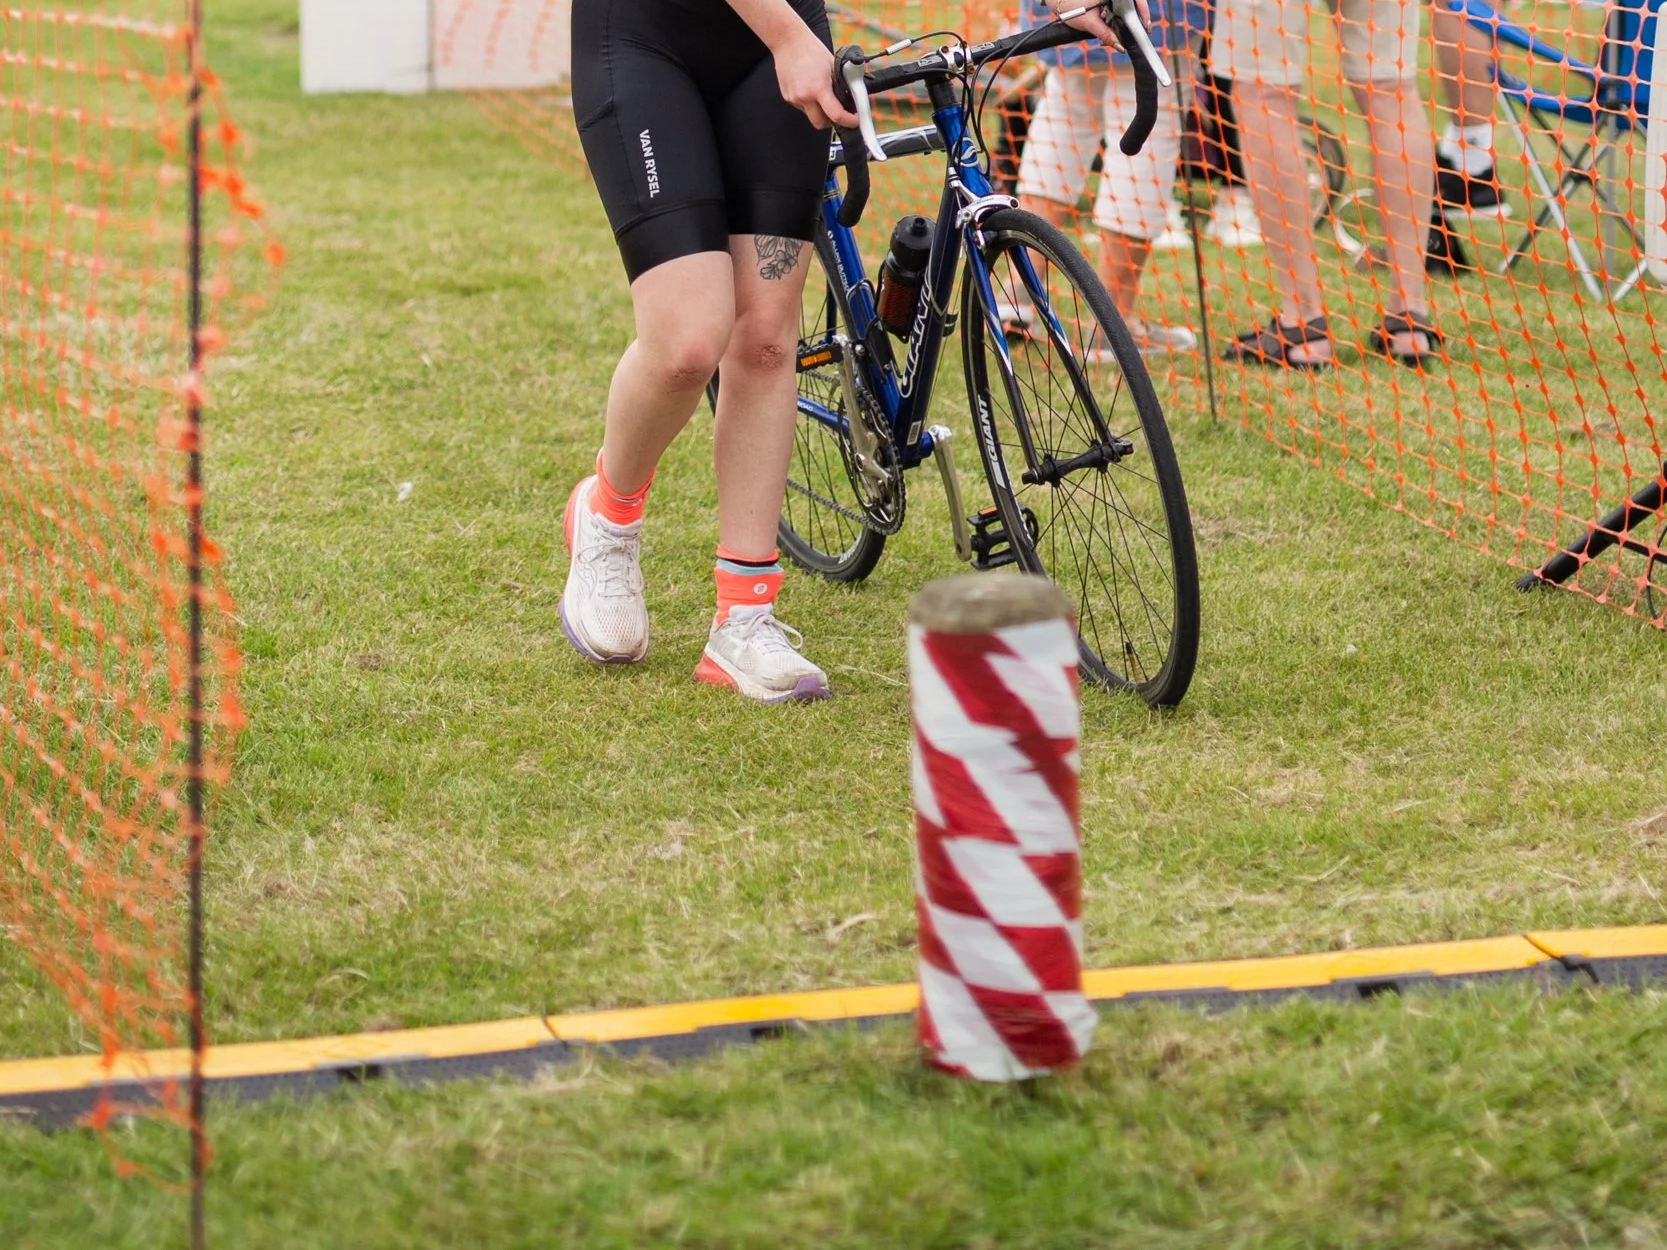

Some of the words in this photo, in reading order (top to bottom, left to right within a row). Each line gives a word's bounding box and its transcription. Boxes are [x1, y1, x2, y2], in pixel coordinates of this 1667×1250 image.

[639, 129, 654, 158] VAN
[645, 159, 660, 198] RYSEL
[977, 394, 998, 462] GIANT
